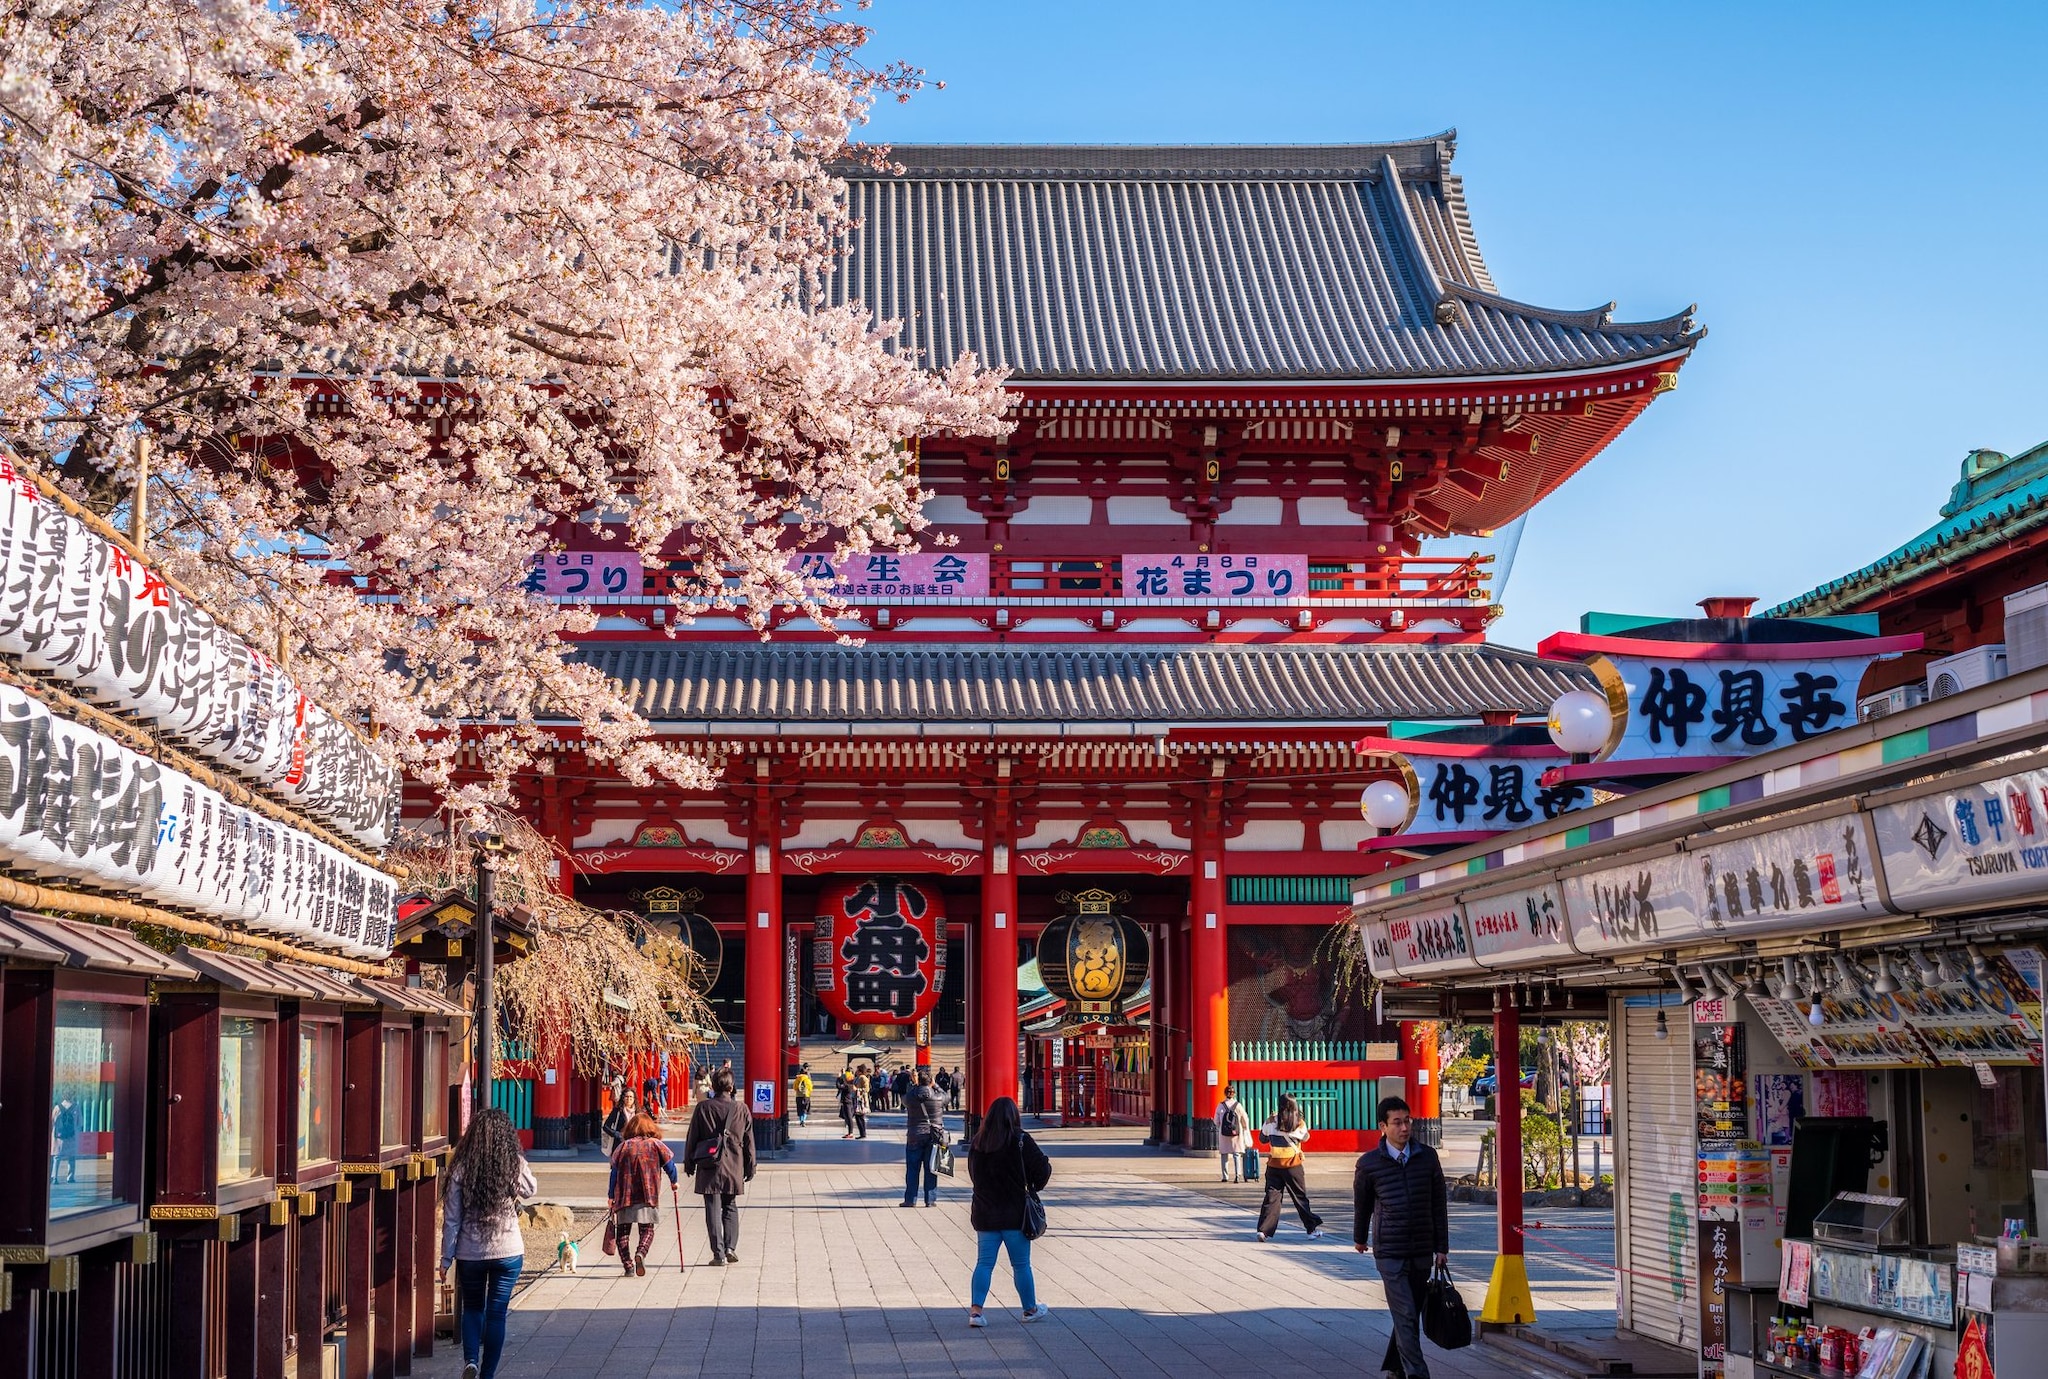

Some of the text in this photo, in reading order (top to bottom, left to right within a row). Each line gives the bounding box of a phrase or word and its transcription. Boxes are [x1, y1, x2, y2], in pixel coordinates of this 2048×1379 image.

[799, 554, 969, 583] 仏生会
[1171, 555, 1258, 569] 4月8日
[821, 583, 955, 596] 釈迦さまのお誕生日
[1135, 566, 1293, 596] 花まつり
[1641, 665, 1846, 749] 仲見世
[1428, 762, 1588, 824] 仲見世
[1966, 851, 2018, 877] TSURUYA
[840, 878, 930, 1019] 小舟町
[1696, 1000, 1723, 1012] FREE
[1696, 1013, 1724, 1022] Wi-Fi
[1711, 1025, 1728, 1069] やき栗
